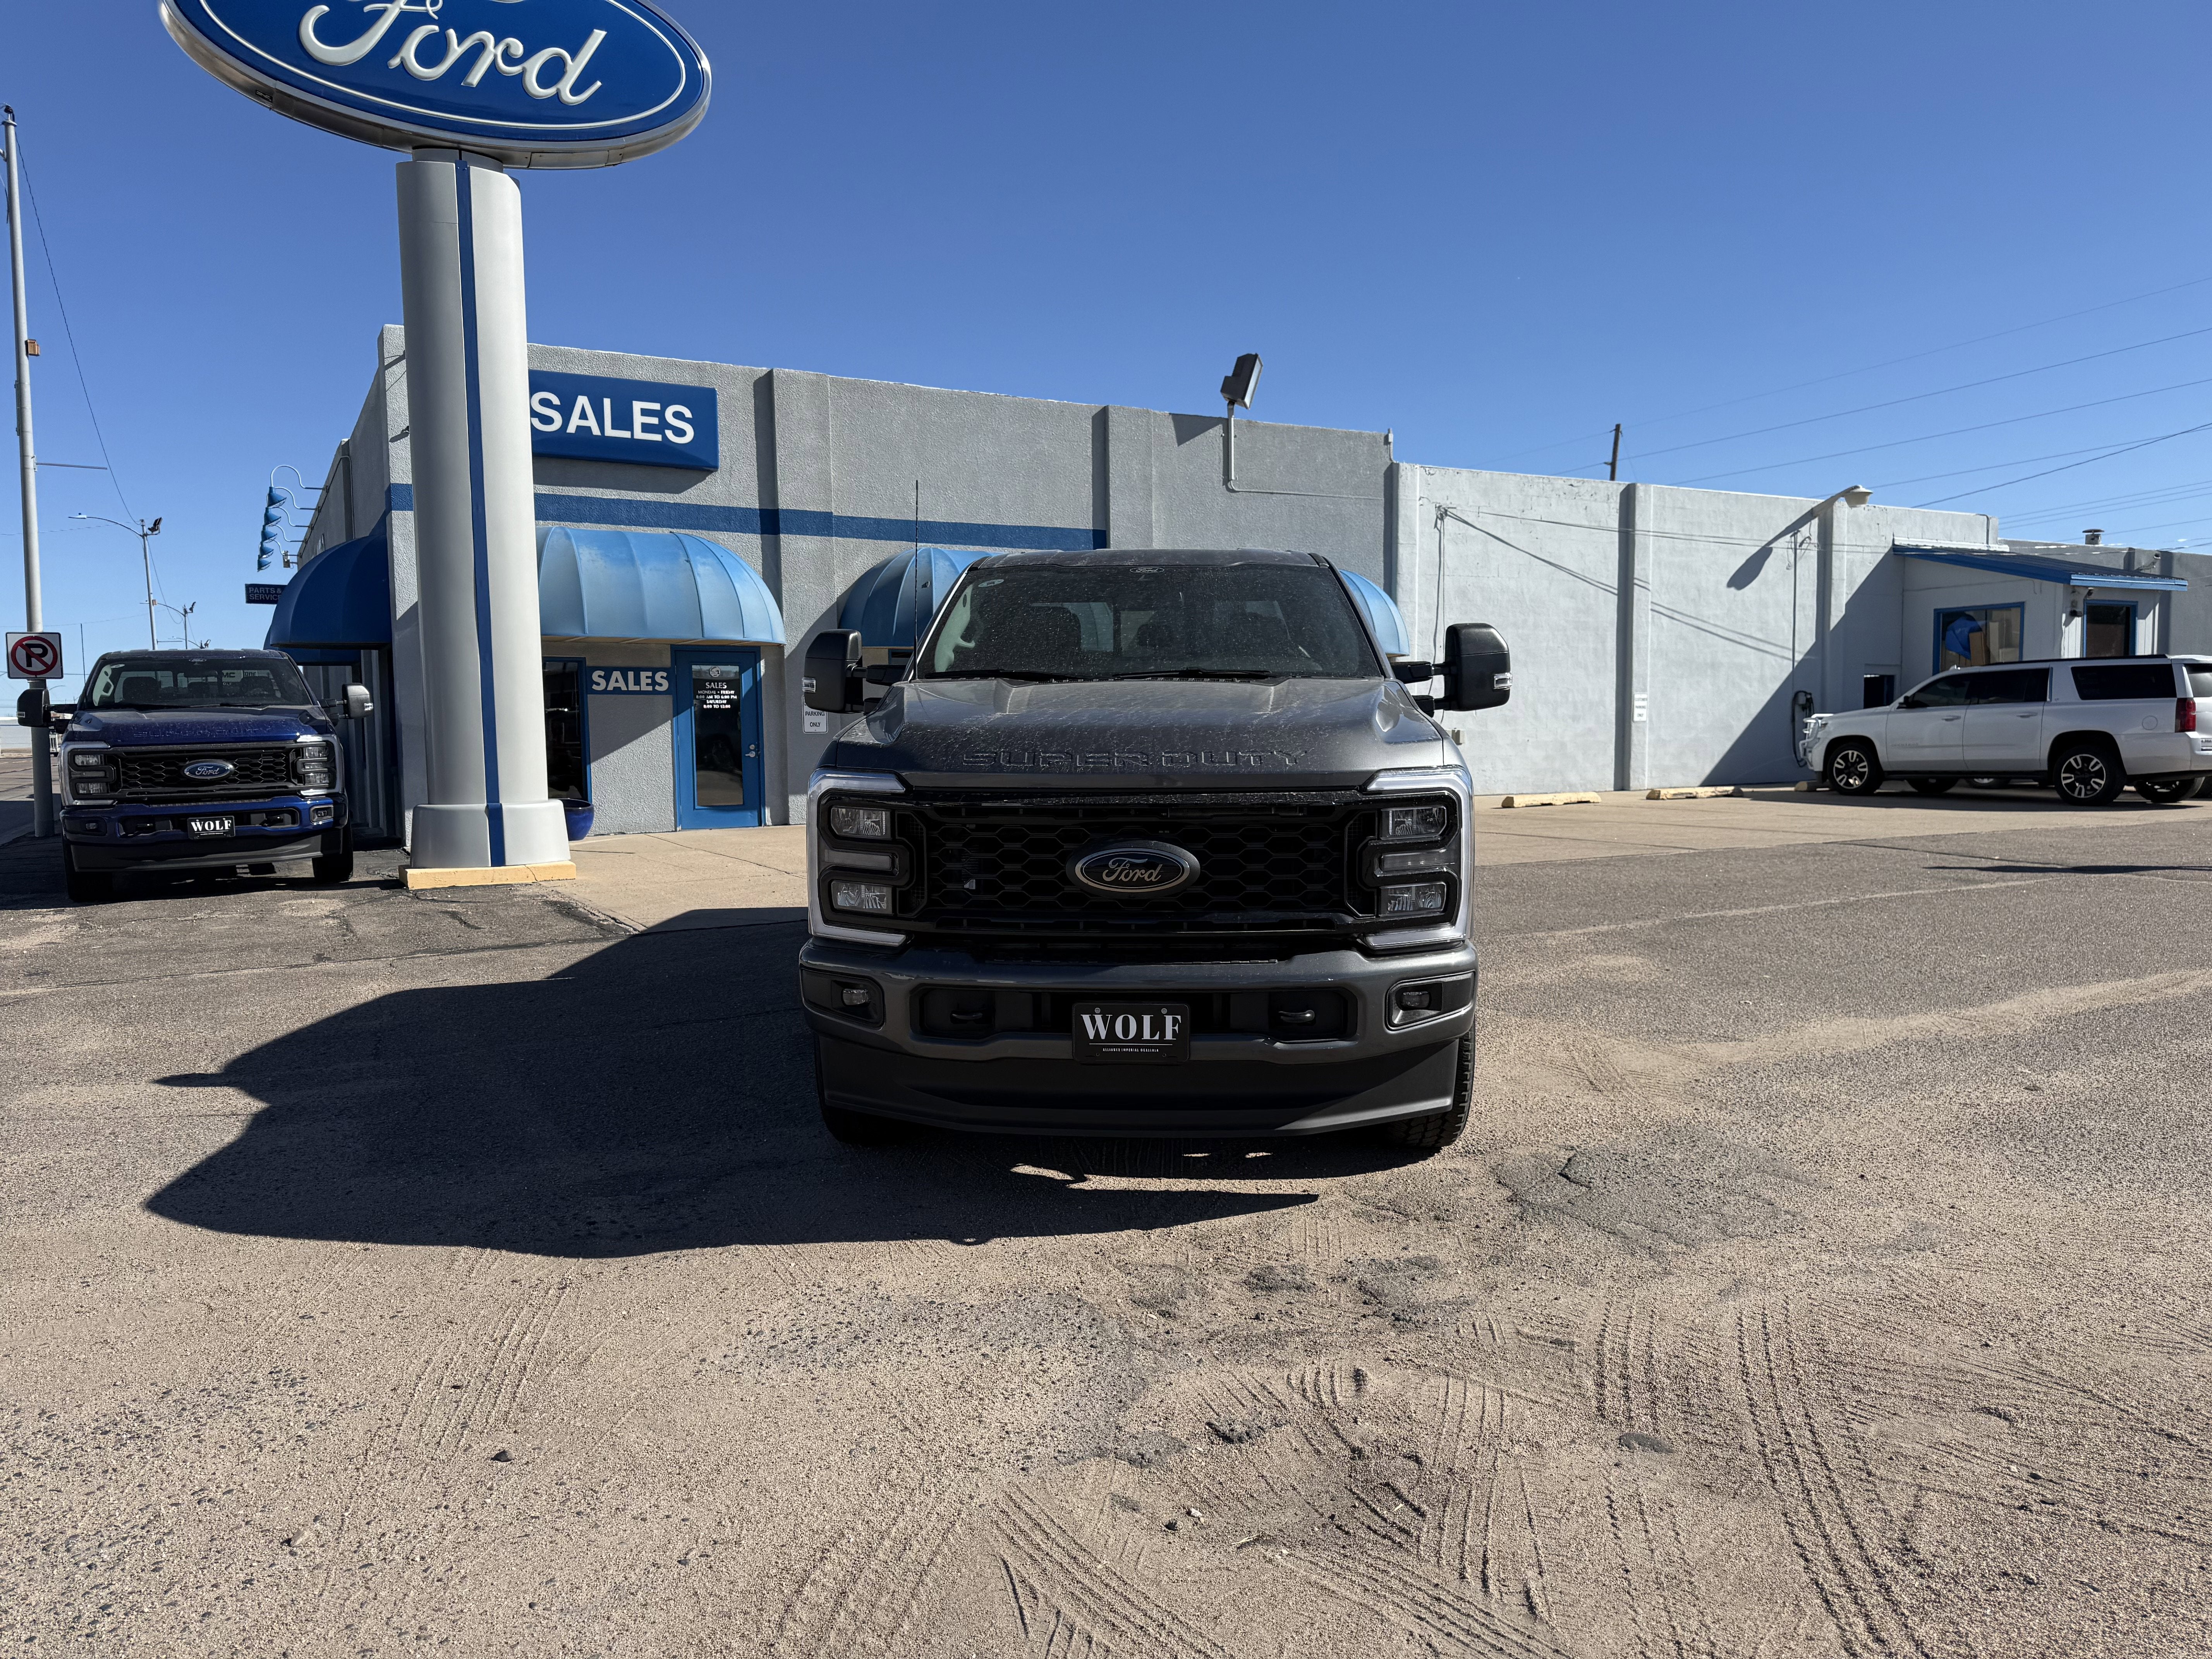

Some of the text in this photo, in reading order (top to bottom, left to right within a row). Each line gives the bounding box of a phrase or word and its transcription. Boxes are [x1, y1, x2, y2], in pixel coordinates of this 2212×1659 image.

[299, 0, 607, 105] Ford
[531, 392, 694, 444] SALES
[592, 670, 669, 691] SALES
[963, 751, 1307, 767] SUPER DUTY
[195, 766, 219, 775] Ford
[191, 820, 232, 831] WOLF
[1102, 857, 1163, 881] Ford
[1080, 1014, 1181, 1040] WOLF
